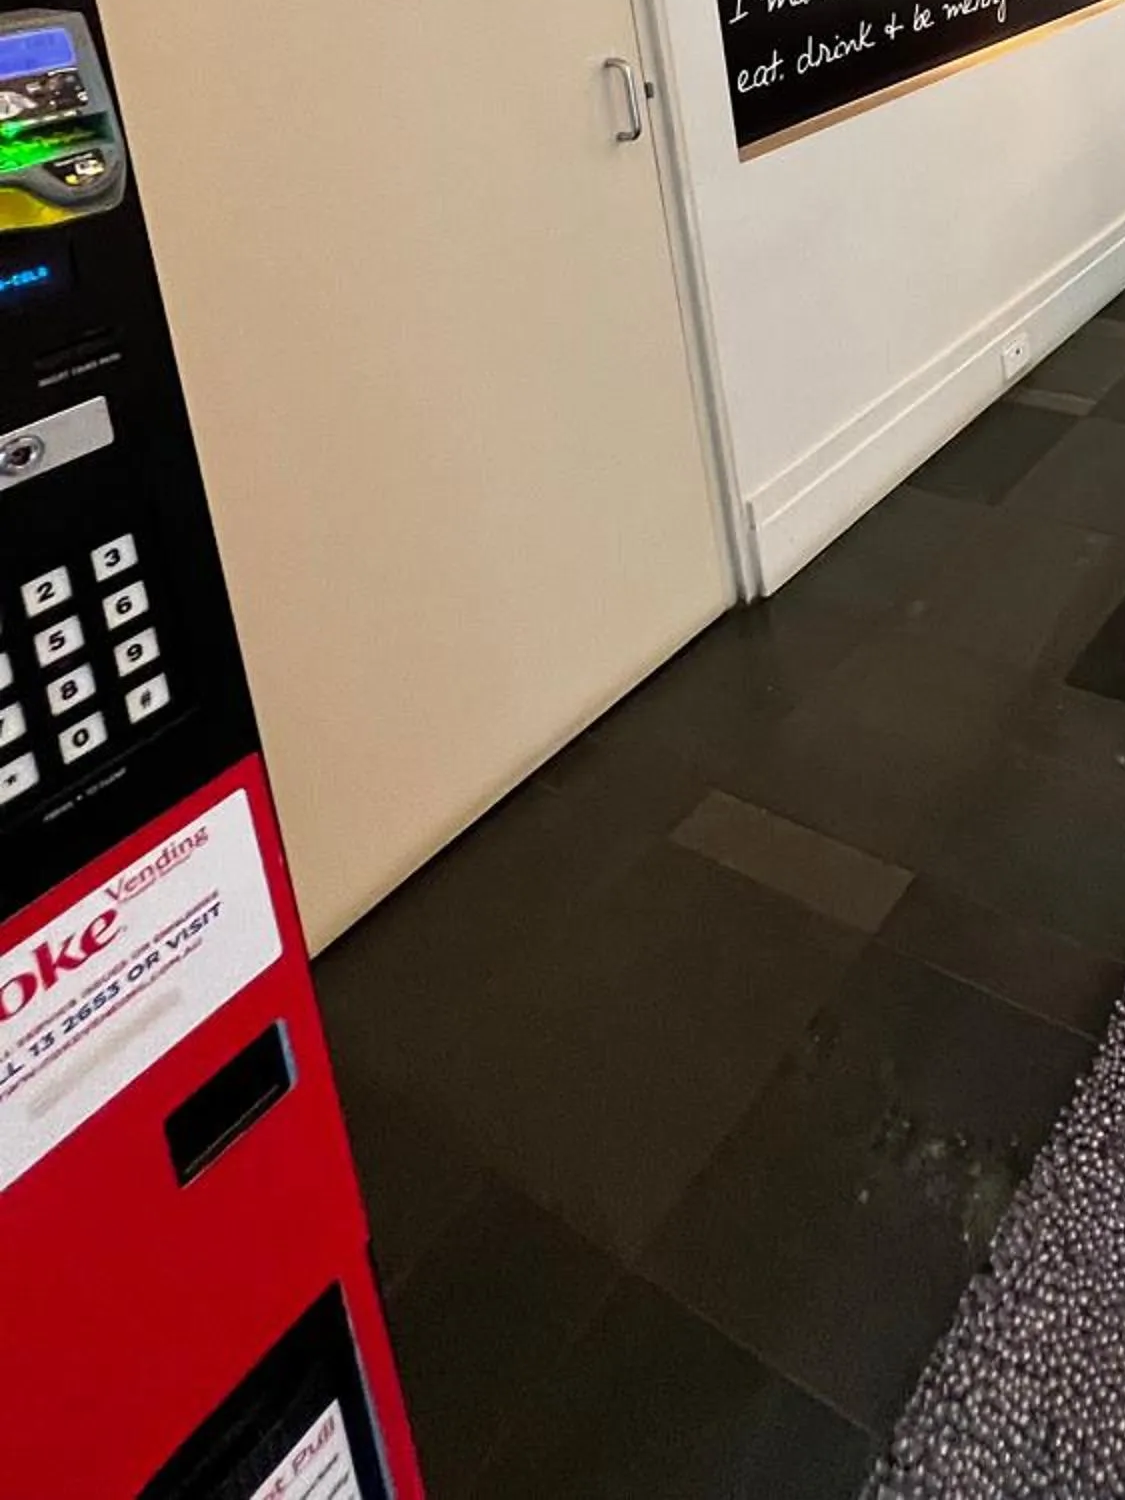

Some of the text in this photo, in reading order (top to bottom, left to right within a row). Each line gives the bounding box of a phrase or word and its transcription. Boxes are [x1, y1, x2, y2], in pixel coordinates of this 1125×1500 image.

[796, 20, 875, 74] drink
[912, 3, 935, 32] be
[37, 548, 121, 603] 2 3
[48, 596, 133, 651] 5 6
[60, 643, 144, 701] 8 9
[72, 727, 90, 748] 0
[105, 826, 208, 901] Vending
[0, 908, 123, 1022] oke
[29, 1031, 56, 1056] 13
[61, 981, 121, 1034] 2653
[127, 951, 160, 982] OR
[166, 901, 222, 950] VISIT
